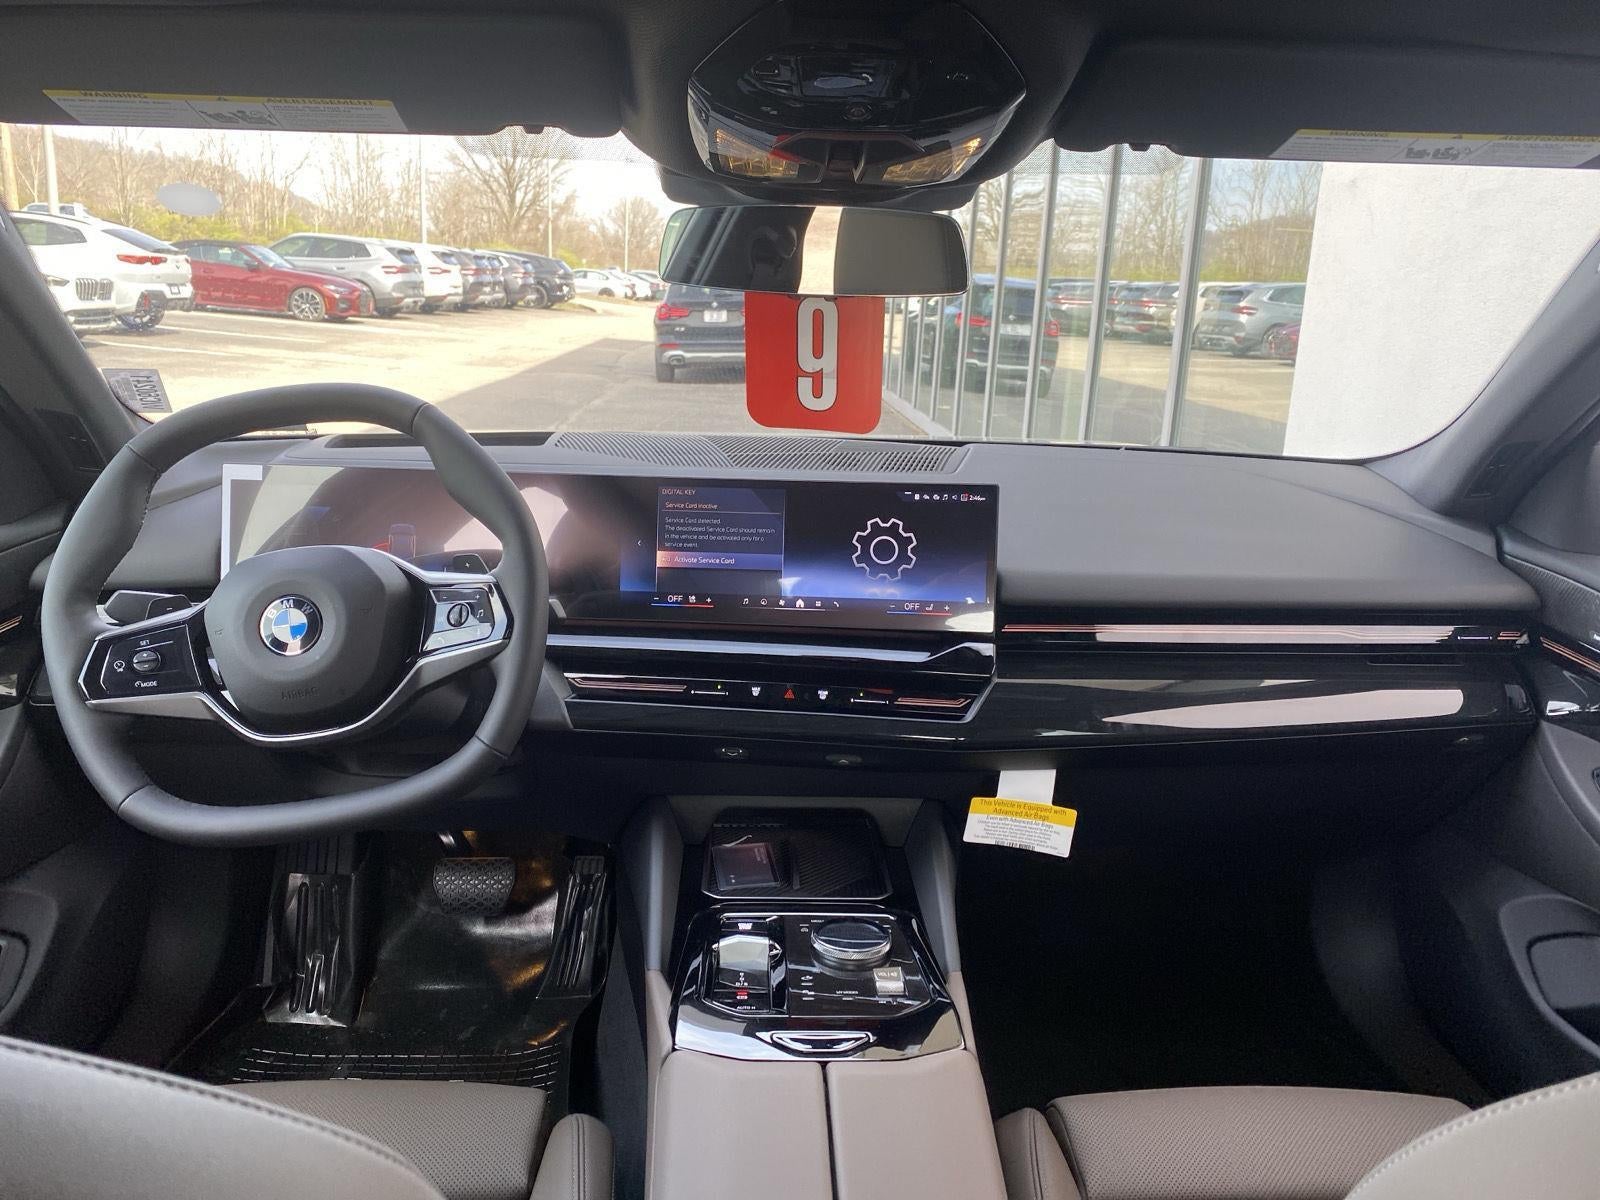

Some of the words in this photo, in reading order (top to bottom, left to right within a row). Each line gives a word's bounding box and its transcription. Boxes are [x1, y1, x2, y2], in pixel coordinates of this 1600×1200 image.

[80, 90, 148, 99] WARNING
[797, 297, 840, 412] 9
[661, 488, 684, 496] DIGITAL
[665, 501, 685, 509] Service
[665, 516, 684, 524] Service
[706, 525, 726, 533] Service
[680, 533, 698, 541] vehicle
[674, 556, 698, 564] Activate
[698, 556, 720, 564] Service
[720, 557, 735, 565] Card
[667, 594, 684, 603] OFF
[904, 602, 921, 611] OFF
[140, 680, 158, 688] MODE
[980, 799, 992, 808] This
[993, 799, 1016, 809] Vehicle
[1016, 802, 1022, 810] is
[1023, 802, 1053, 815] Equipped
[1053, 808, 1067, 817] with
[993, 807, 1024, 818] Advanced
[1024, 811, 1033, 819] Air
[1033, 812, 1050, 822] Bags
